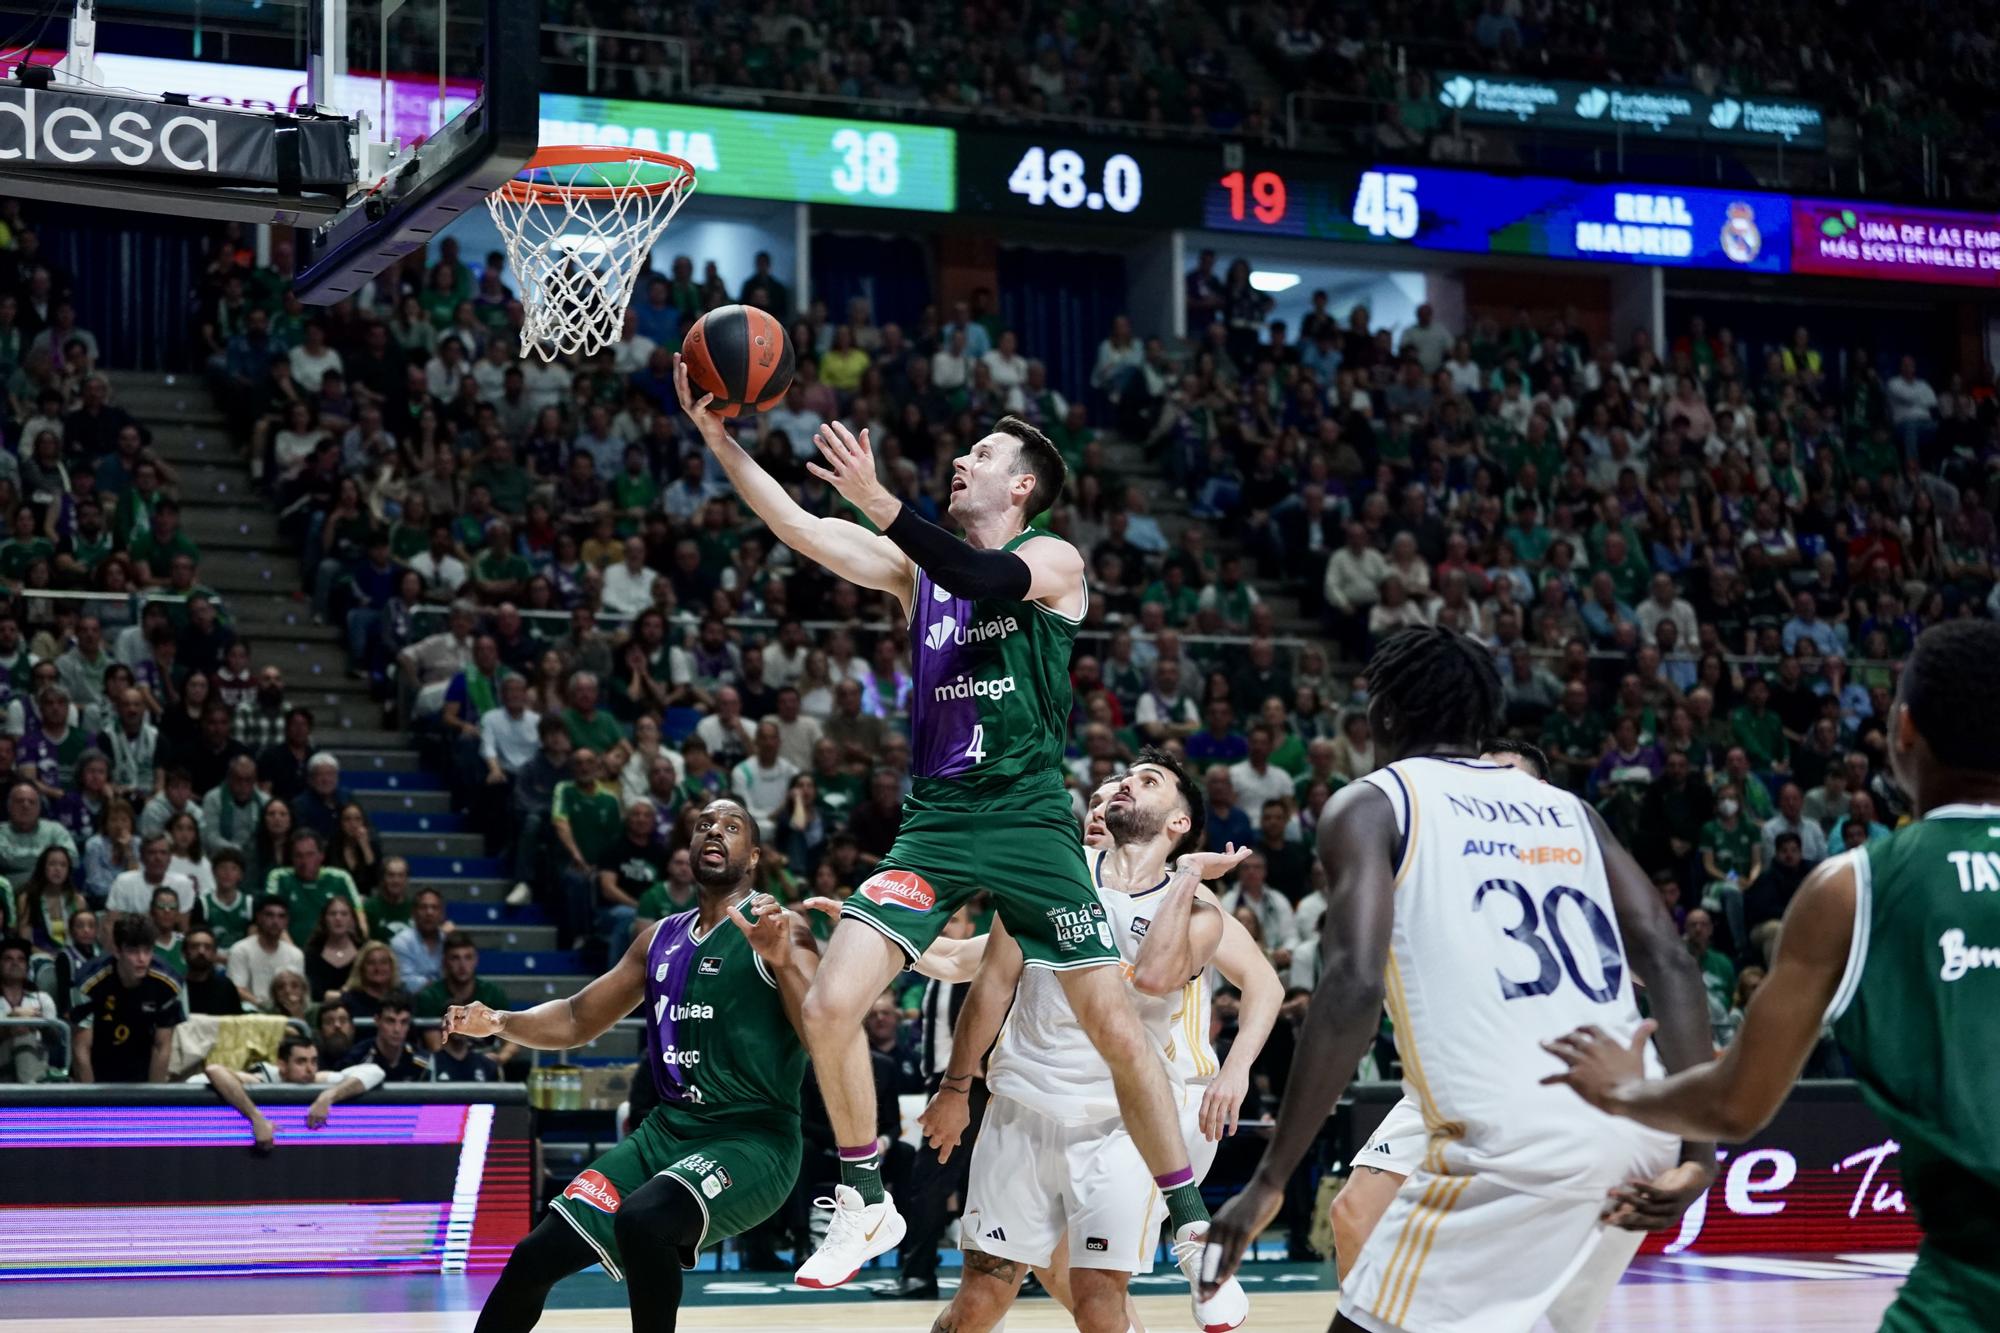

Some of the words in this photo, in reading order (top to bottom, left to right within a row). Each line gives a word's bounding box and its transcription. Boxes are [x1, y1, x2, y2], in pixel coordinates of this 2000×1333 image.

[830, 129, 899, 196] 38
[1008, 146, 1143, 213] 48.0
[1221, 171, 1287, 224] 19
[1352, 171, 1419, 239] 45
[1614, 192, 1693, 227] REAL
[1576, 221, 1693, 257] MADRID
[1820, 235, 1859, 260] MÁS
[1861, 241, 1977, 268] SOSTENIBLES
[1859, 221, 1899, 243] UNA
[1900, 224, 1926, 245] DE
[1928, 226, 1962, 247] LAS
[964, 724, 987, 764] 4
[1444, 792, 1575, 828] NDIAYE
[1055, 922, 1097, 944] laga
[1472, 878, 1622, 1003] 30
